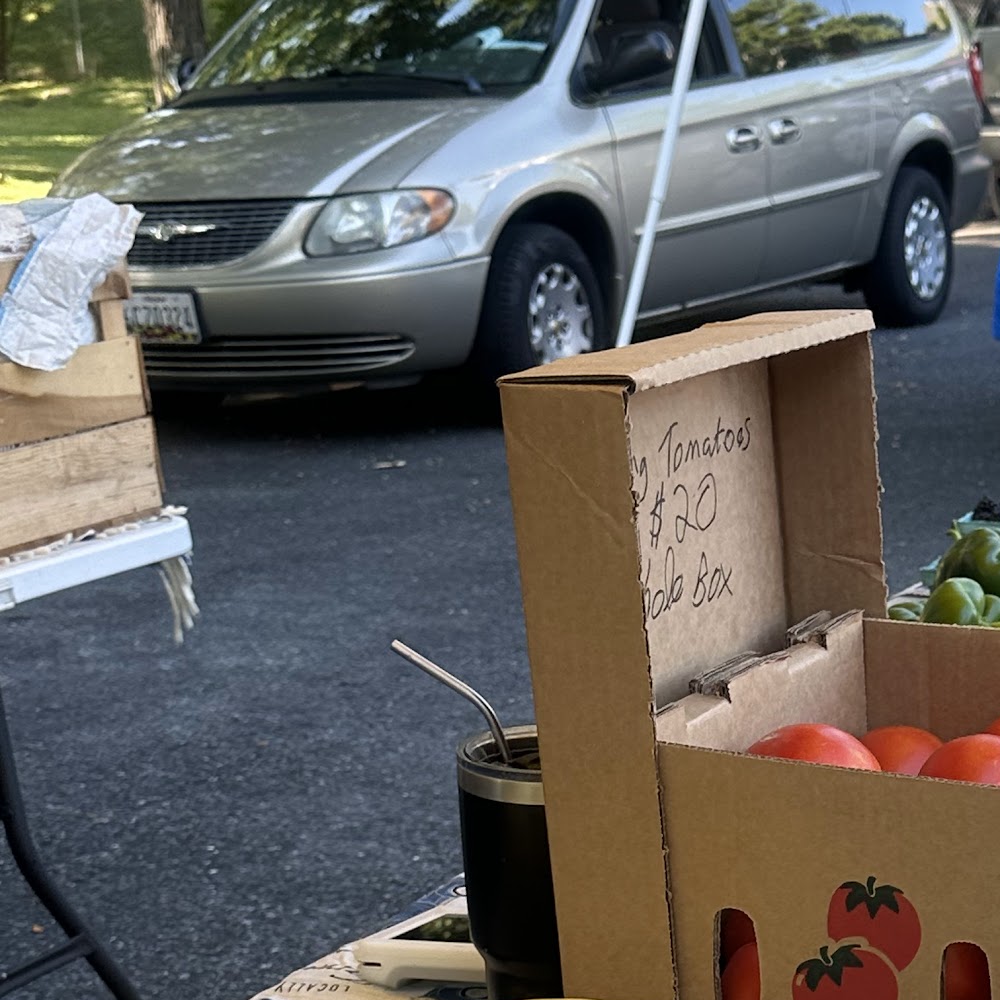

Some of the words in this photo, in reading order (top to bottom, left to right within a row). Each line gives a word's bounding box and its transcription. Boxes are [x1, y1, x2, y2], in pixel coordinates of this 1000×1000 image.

[650, 473, 717, 550] $20
[692, 551, 733, 608] Box
[275, 981, 351, 994] LOCALLY
